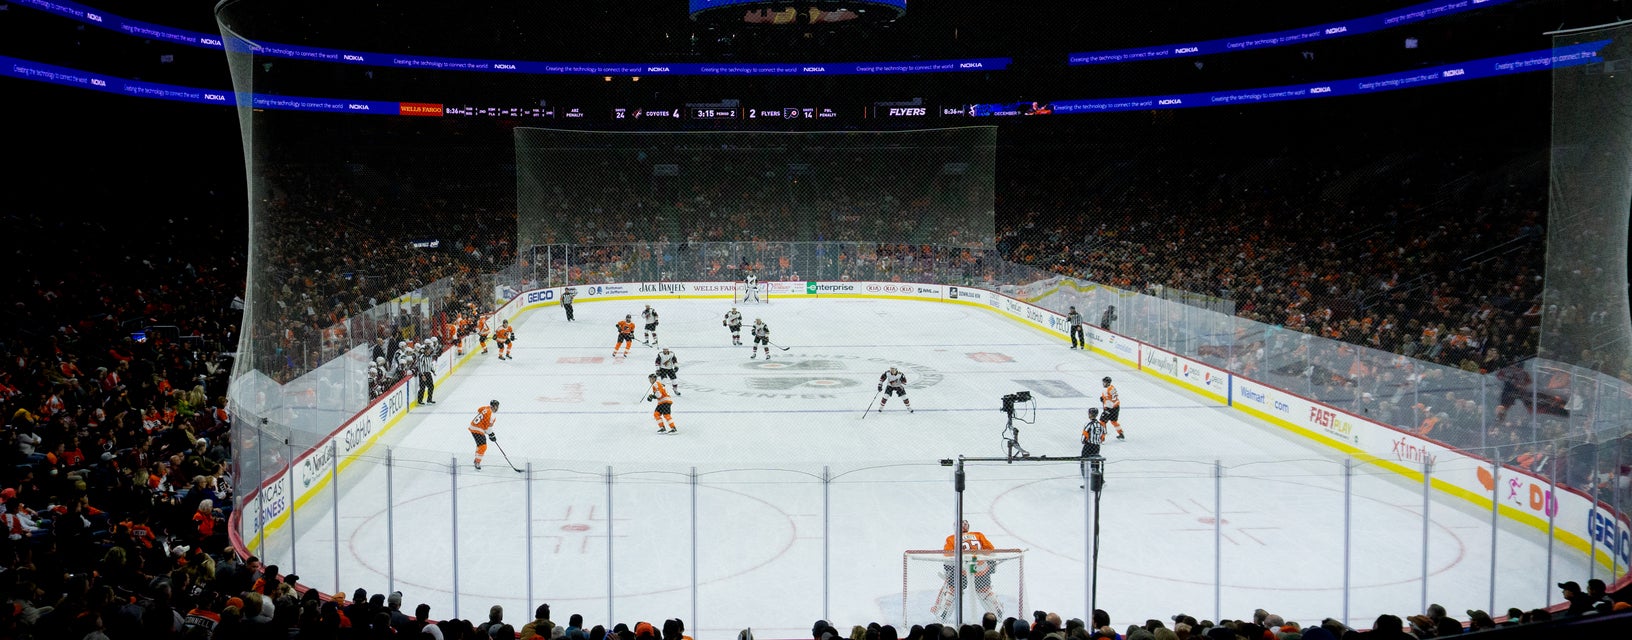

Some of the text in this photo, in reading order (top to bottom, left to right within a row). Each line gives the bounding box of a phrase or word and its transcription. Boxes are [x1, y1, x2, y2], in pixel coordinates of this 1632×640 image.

[1325, 26, 1347, 35] NOKIA
[200, 38, 221, 46] NOKIA
[1443, 68, 1464, 77] NOKIA
[1310, 86, 1331, 94] NOKIA
[673, 109, 680, 118] 4
[749, 109, 756, 118] 2
[889, 108, 926, 116] FLYERS
[639, 282, 656, 292] JACK
[811, 283, 853, 292] enterprise
[528, 290, 553, 303] GEICO
[1056, 317, 1070, 333] PECO
[1240, 385, 1265, 404] Walmart
[388, 390, 403, 418] PECO
[1310, 406, 1337, 430] FAST
[1334, 418, 1352, 435] PLAY
[345, 415, 372, 452] StubHub
[1392, 437, 1436, 467] xfinity
[253, 478, 285, 514] CMCAST
[1529, 483, 1558, 518] DD
[253, 496, 285, 533] BSINESS
